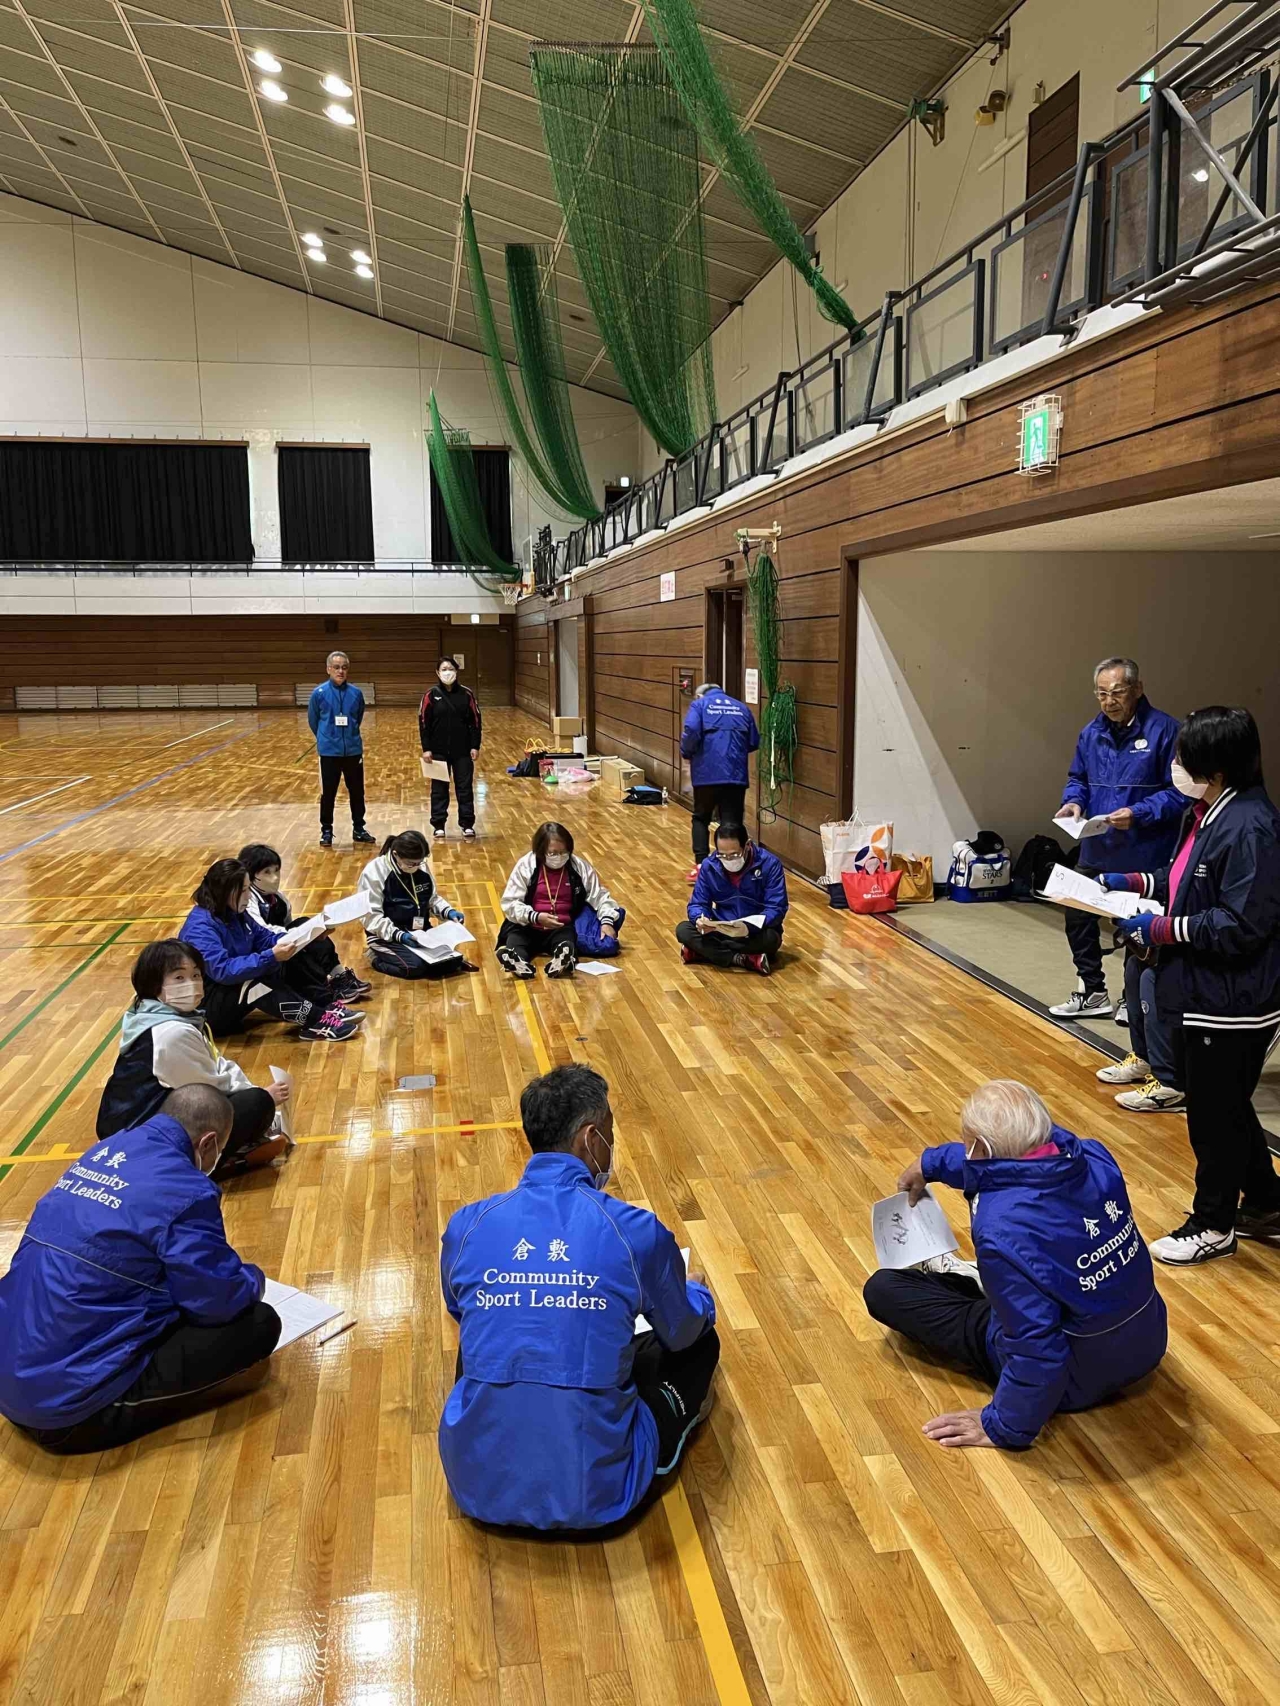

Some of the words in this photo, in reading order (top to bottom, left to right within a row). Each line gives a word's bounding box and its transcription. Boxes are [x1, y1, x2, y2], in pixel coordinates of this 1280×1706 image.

[70, 1181, 123, 1209] Leaders
[512, 1237, 570, 1262] 倉敷
[483, 1268, 600, 1289] Community
[1079, 1260, 1117, 1291] Sport
[476, 1289, 521, 1310] Sport
[529, 1289, 607, 1310] Leaders
